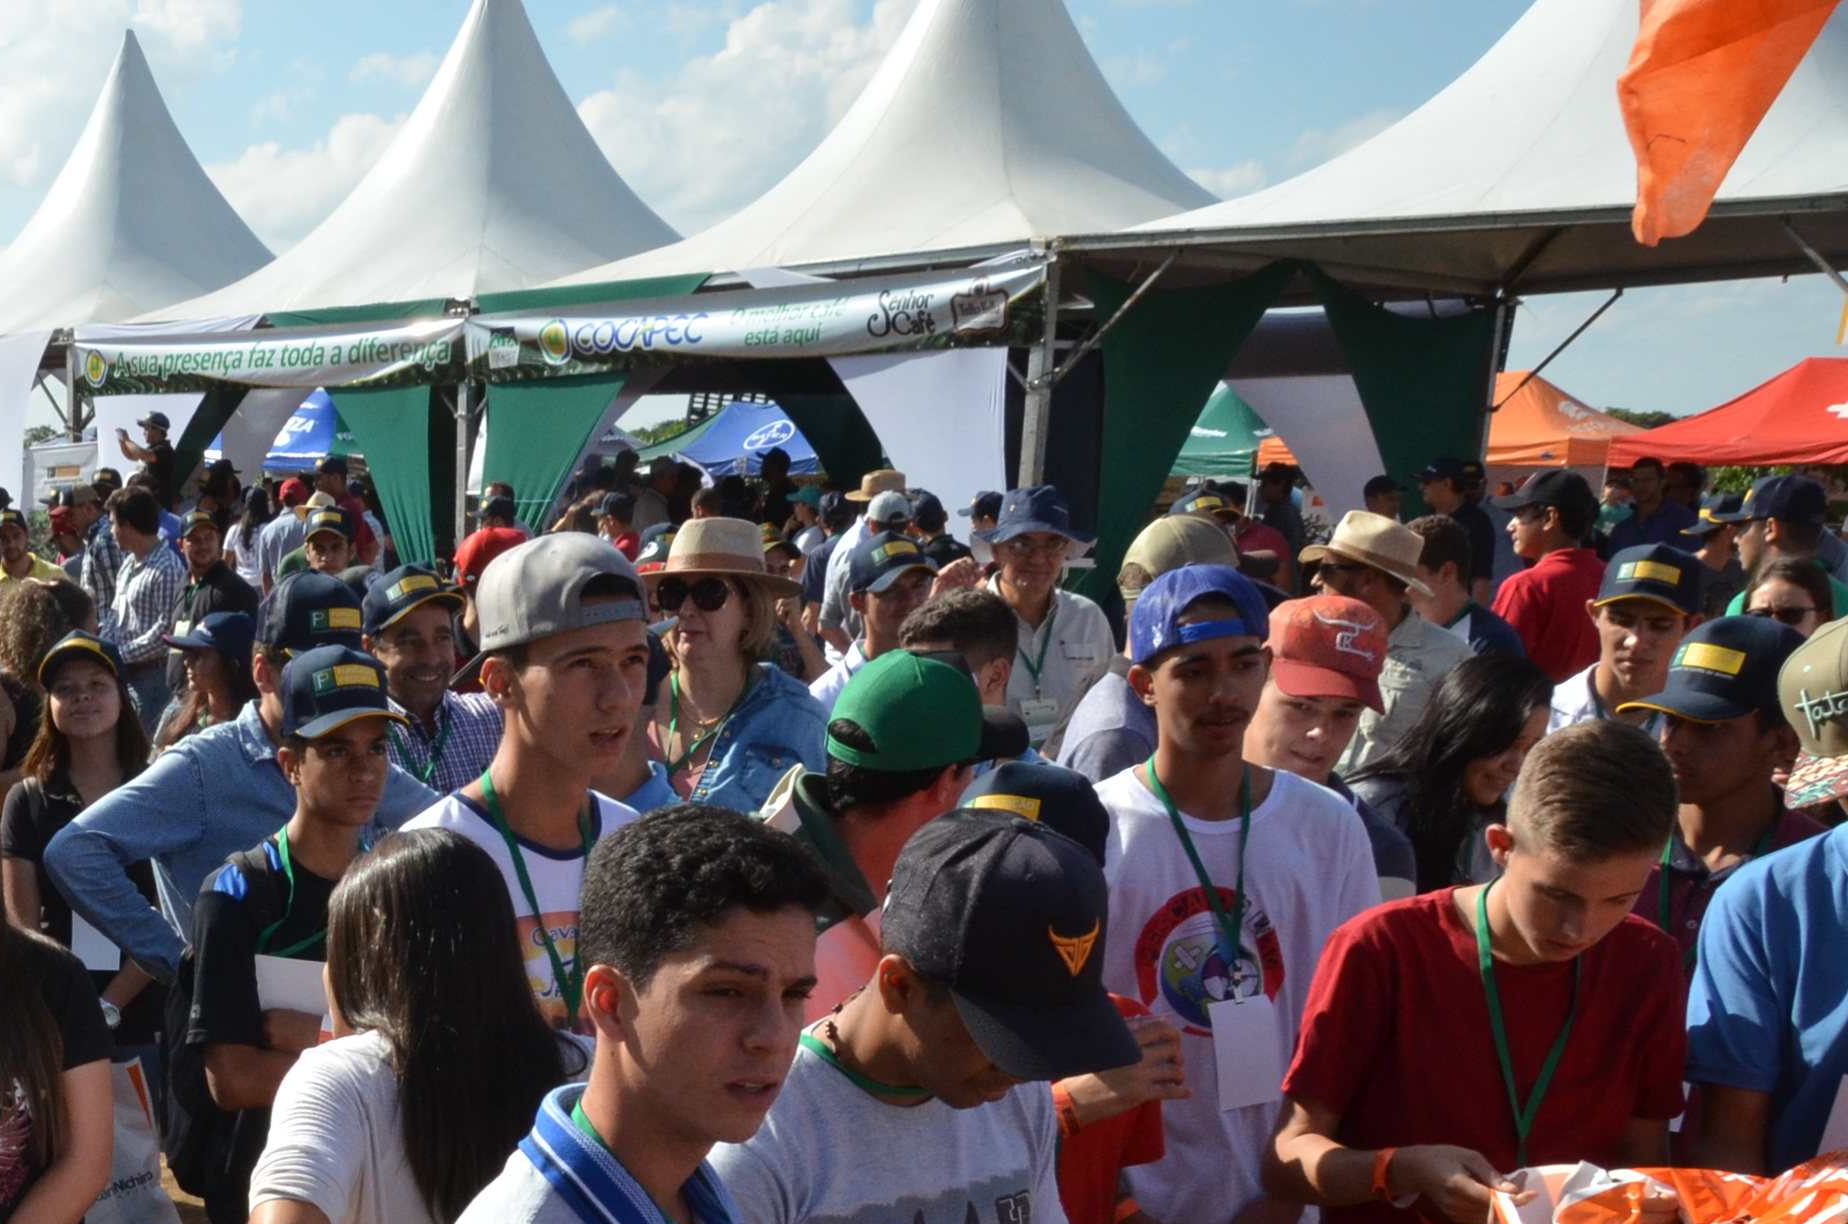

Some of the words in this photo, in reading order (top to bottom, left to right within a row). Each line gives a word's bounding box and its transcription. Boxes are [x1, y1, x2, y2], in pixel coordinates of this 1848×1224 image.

[574, 313, 709, 352] COCAPEC
[867, 289, 935, 338] Senhor
[891, 310, 936, 336] Café
[744, 325, 779, 347] está
[783, 322, 822, 347] aqui
[114, 351, 131, 377] A
[131, 356, 160, 375] sua
[161, 347, 243, 380] presença
[248, 340, 277, 371] faz
[280, 337, 326, 367] toda
[330, 344, 346, 365] a
[348, 336, 451, 372] diferença
